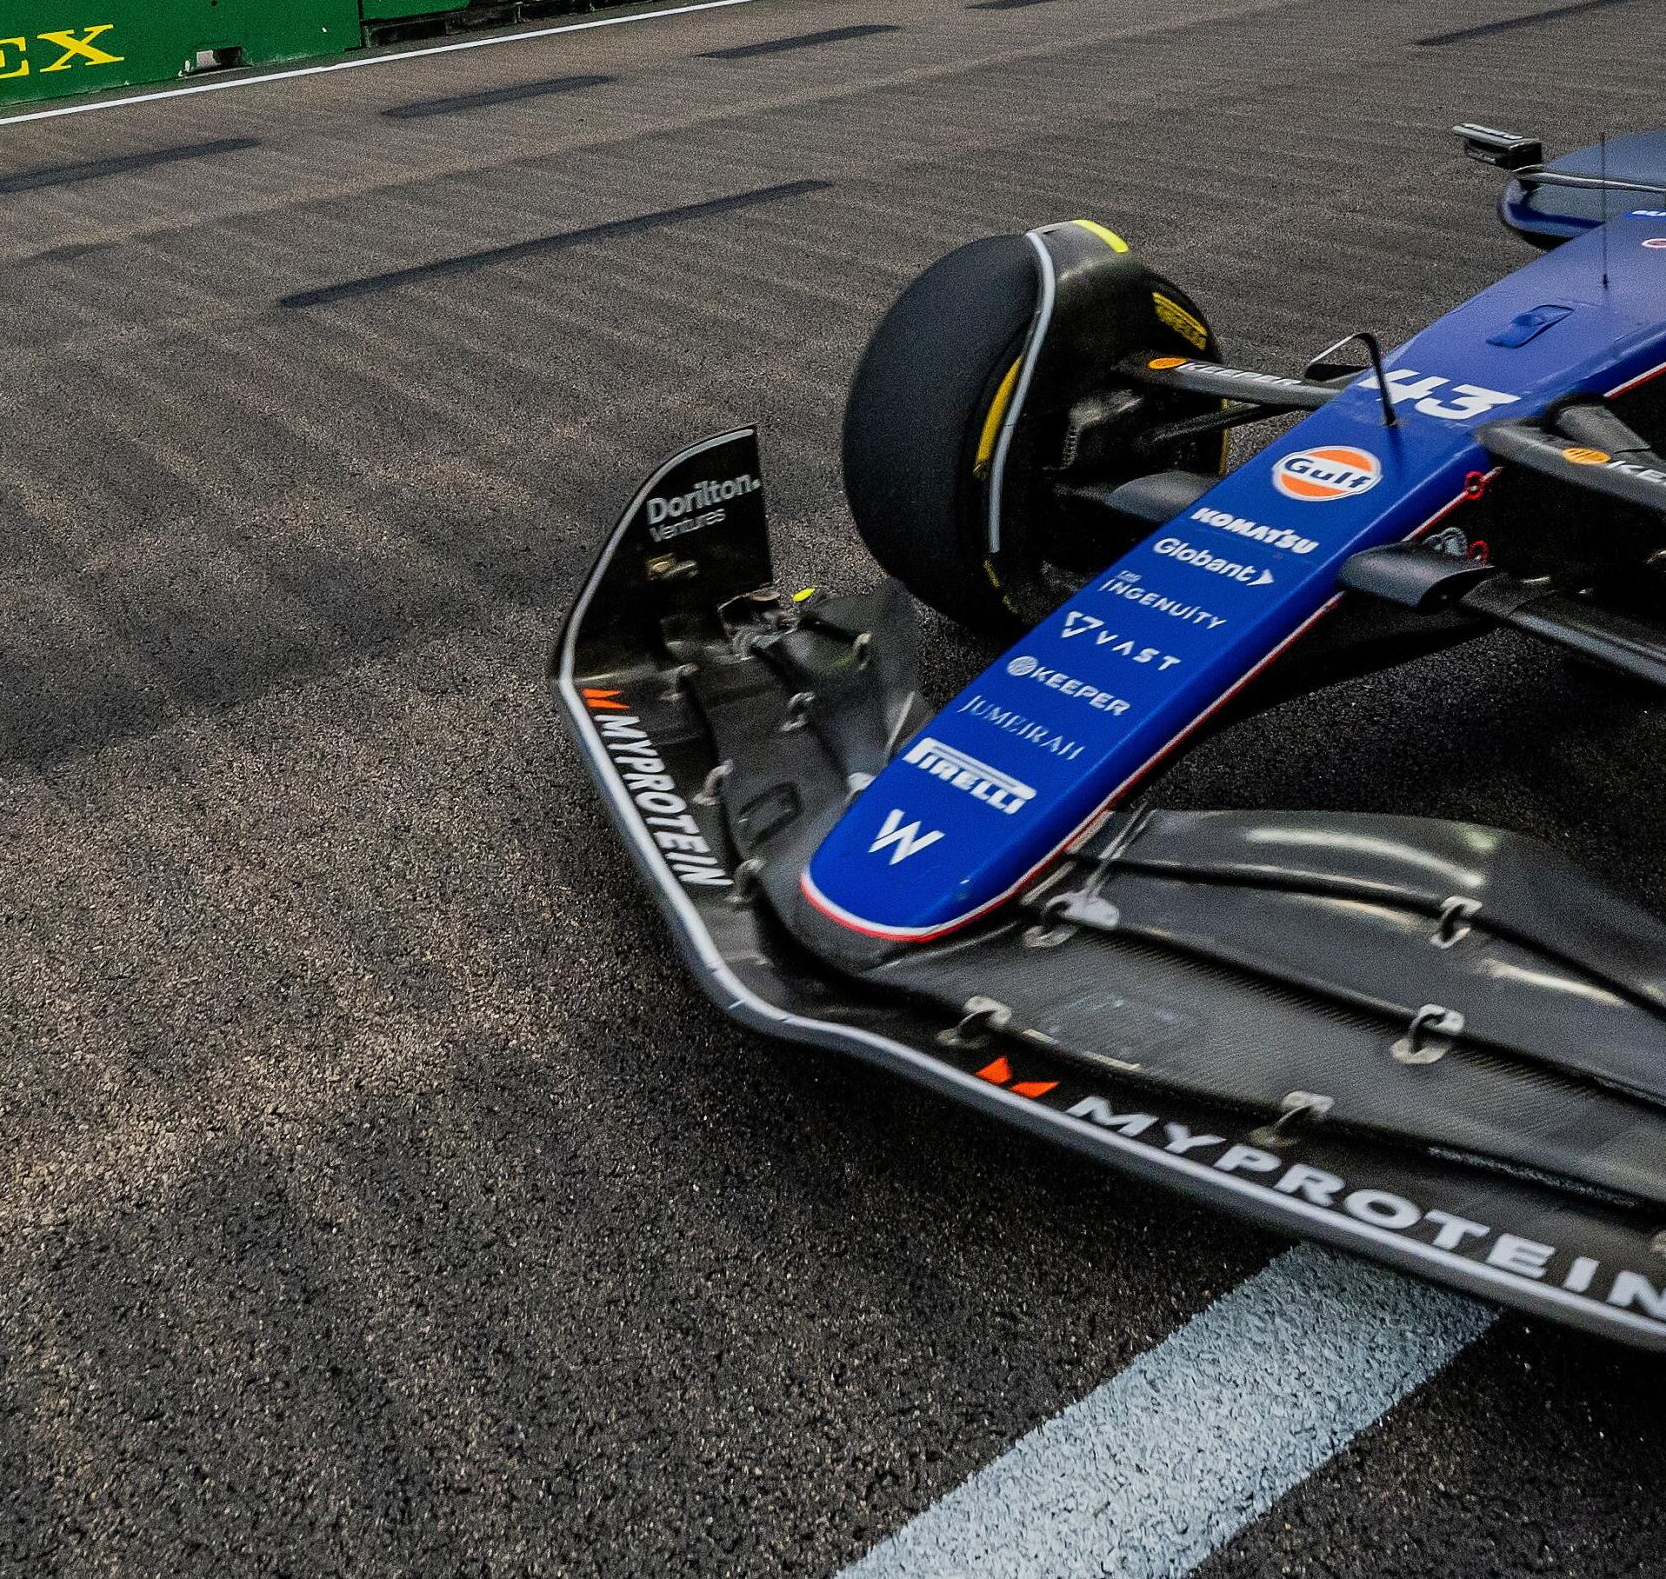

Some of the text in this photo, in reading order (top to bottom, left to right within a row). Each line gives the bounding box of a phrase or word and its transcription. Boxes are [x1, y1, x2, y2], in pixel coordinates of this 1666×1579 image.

[1356, 368, 1522, 420] 43
[1284, 456, 1374, 490] Gulf
[649, 507, 727, 543] Ventures
[1190, 507, 1320, 555] KOMATSU
[1152, 536, 1256, 585] Globant
[1095, 629, 1182, 671] VAST
[1031, 664, 1132, 717] KEEPER
[957, 694, 1086, 761] JUMEIRAH
[594, 714, 734, 887] MYPROTEIN
[901, 736, 1037, 815] PIRELLI
[868, 807, 946, 866] W
